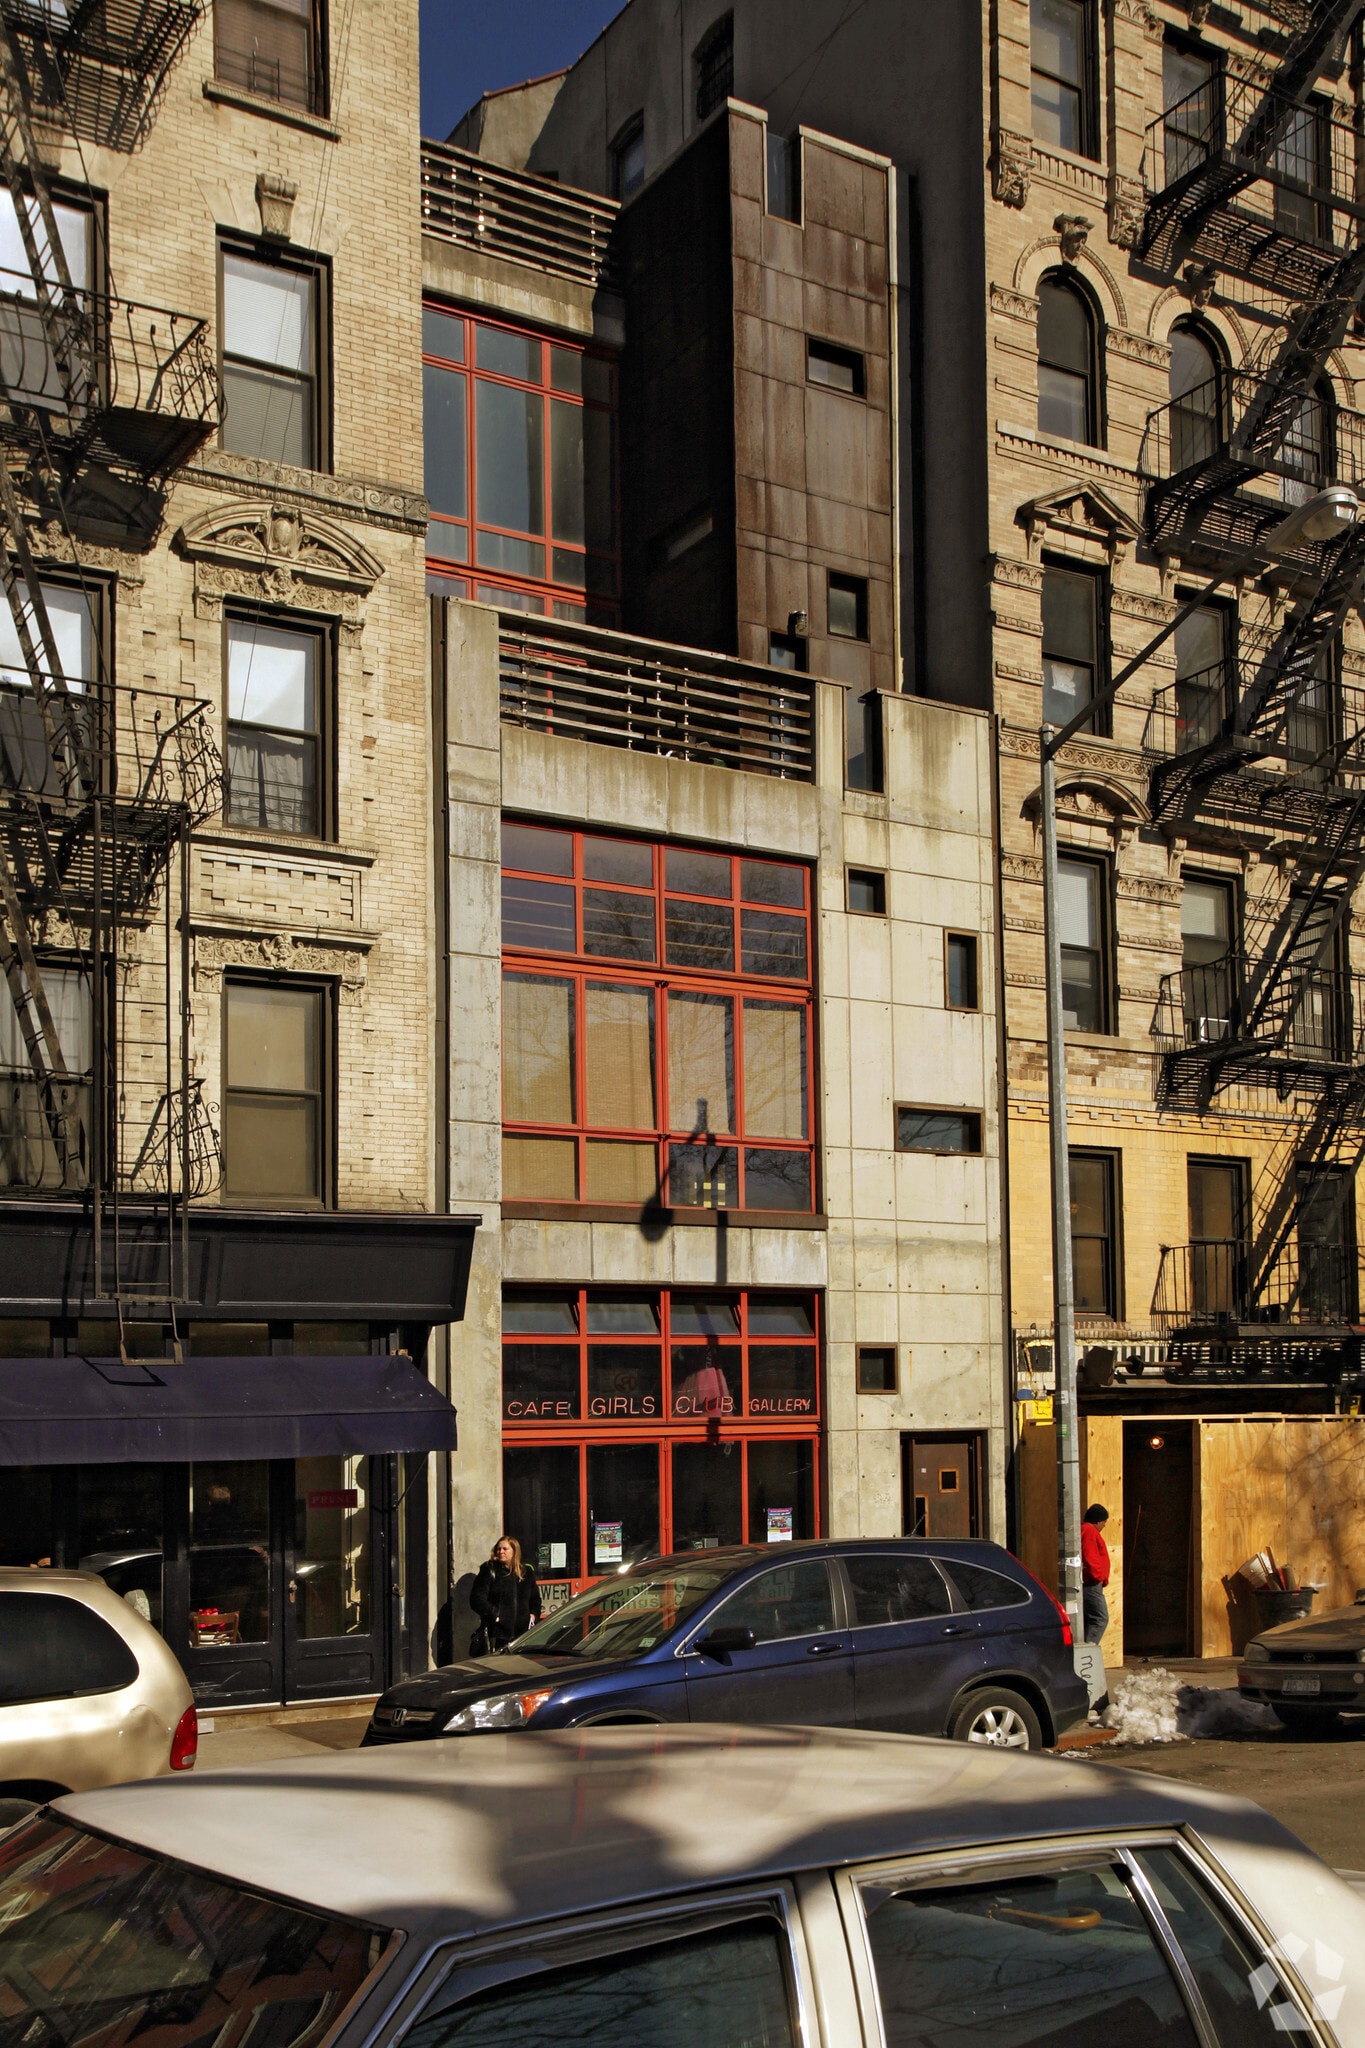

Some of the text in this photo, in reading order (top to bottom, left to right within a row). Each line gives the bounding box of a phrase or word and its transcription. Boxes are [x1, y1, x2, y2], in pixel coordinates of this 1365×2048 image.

[507, 1396, 811, 1416] CAFE GIRLS CLUB GALLERY
